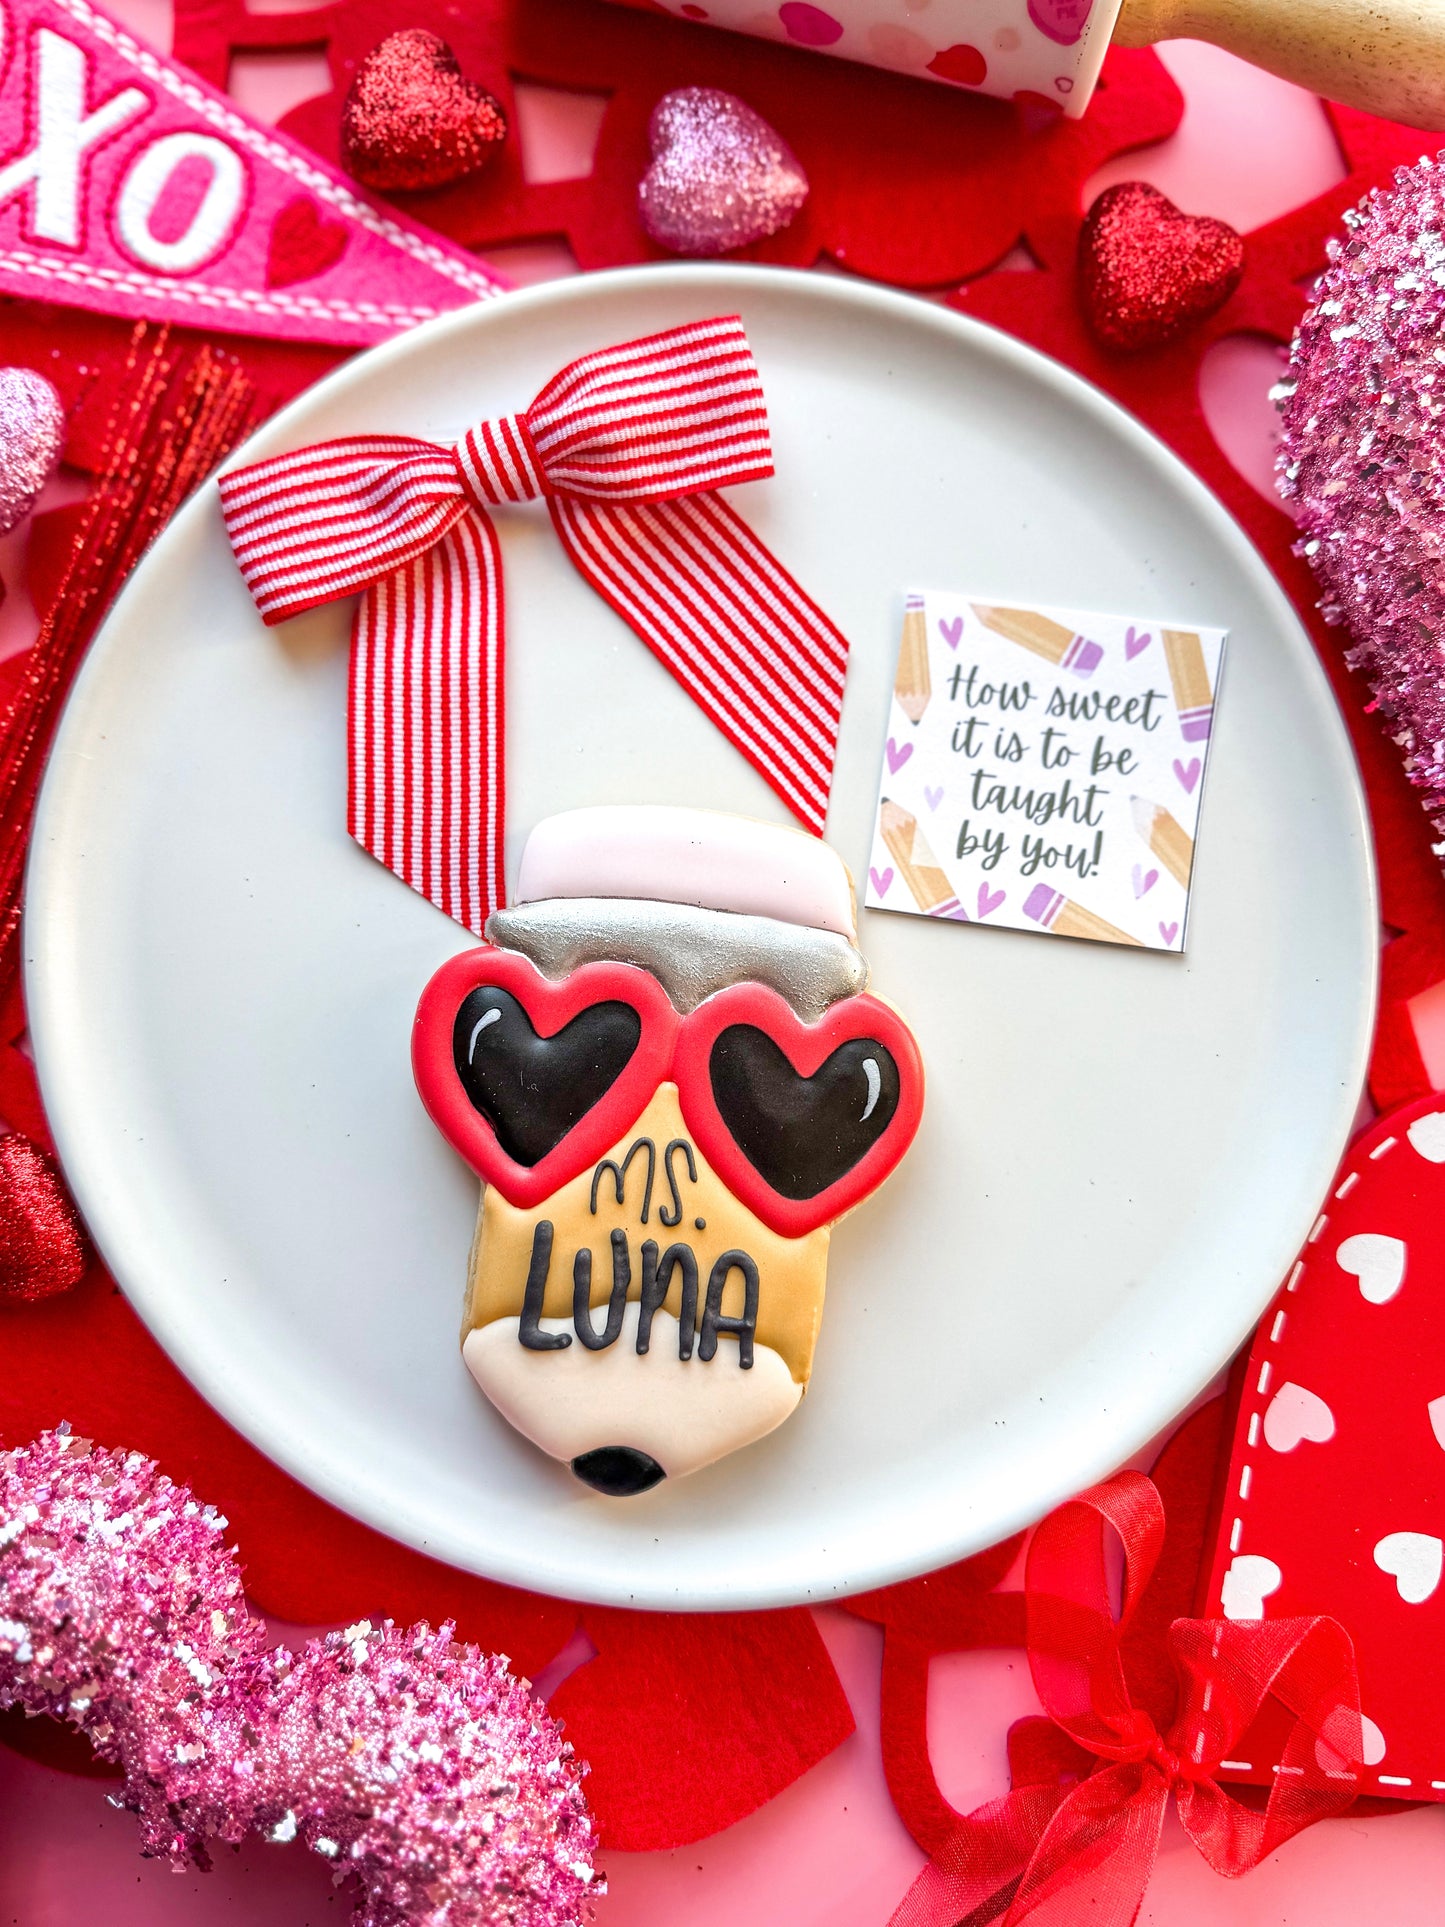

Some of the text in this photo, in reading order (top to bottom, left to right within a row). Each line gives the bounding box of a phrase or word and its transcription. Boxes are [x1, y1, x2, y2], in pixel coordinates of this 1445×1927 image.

[946, 663, 1168, 732] How sweet
[951, 716, 1139, 775] it is to be
[970, 768, 1110, 827] taught
[956, 819, 1103, 879] by you!
[590, 1137, 706, 1230] MS.
[518, 1219, 760, 1369] LUNA
